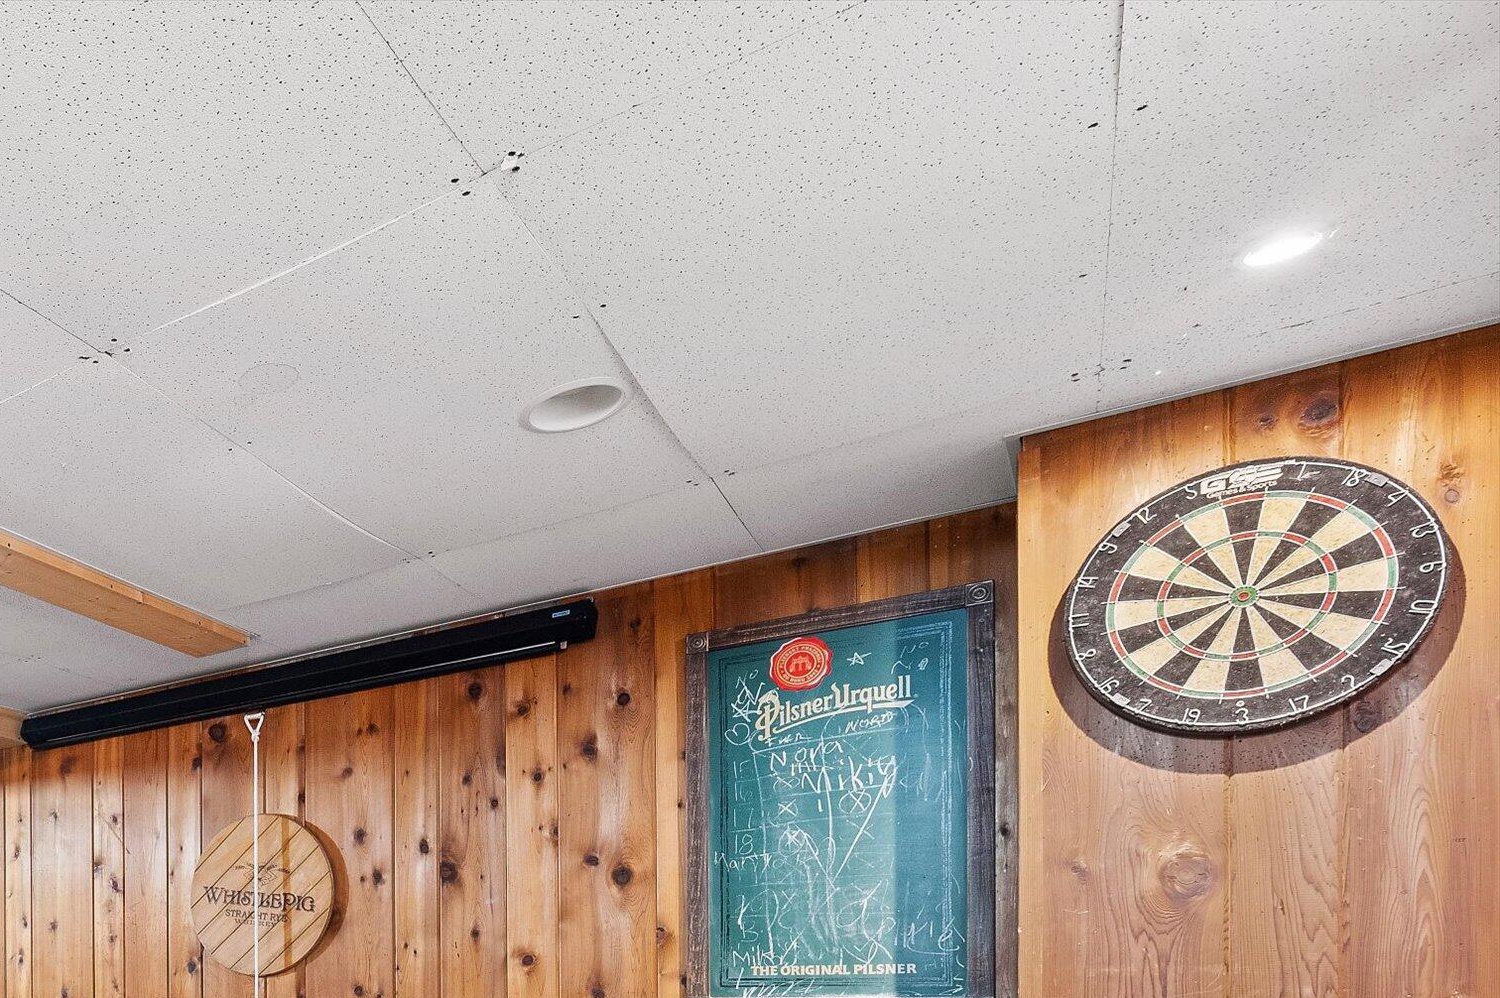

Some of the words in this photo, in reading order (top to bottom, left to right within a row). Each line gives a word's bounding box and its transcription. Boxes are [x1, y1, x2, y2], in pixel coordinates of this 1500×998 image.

[1342, 467, 1367, 487] 18
[1184, 484, 1198, 500] 5
[1207, 487, 1238, 498] Games
[1246, 480, 1278, 492] Sports
[1387, 489, 1408, 507] 4
[1135, 506, 1157, 525] 12
[1410, 518, 1438, 538] 13
[1098, 541, 1118, 554] 9
[1077, 575, 1099, 589] 14
[1409, 599, 1438, 615] 10
[1070, 612, 1090, 629] 11
[1076, 648, 1097, 661] 8
[1381, 637, 1409, 656] 15
[1095, 676, 1120, 694] 16
[1341, 674, 1356, 689] 2
[755, 689, 833, 742] Pilsner
[831, 675, 912, 714] Urquell
[1135, 699, 1152, 713] 7
[1288, 695, 1310, 714] 17
[1181, 706, 1201, 723] 19
[1235, 707, 1249, 724] 3
[750, 964, 778, 976] THE
[780, 963, 851, 976] ORIGINAL
[853, 963, 918, 975] PILSNER
